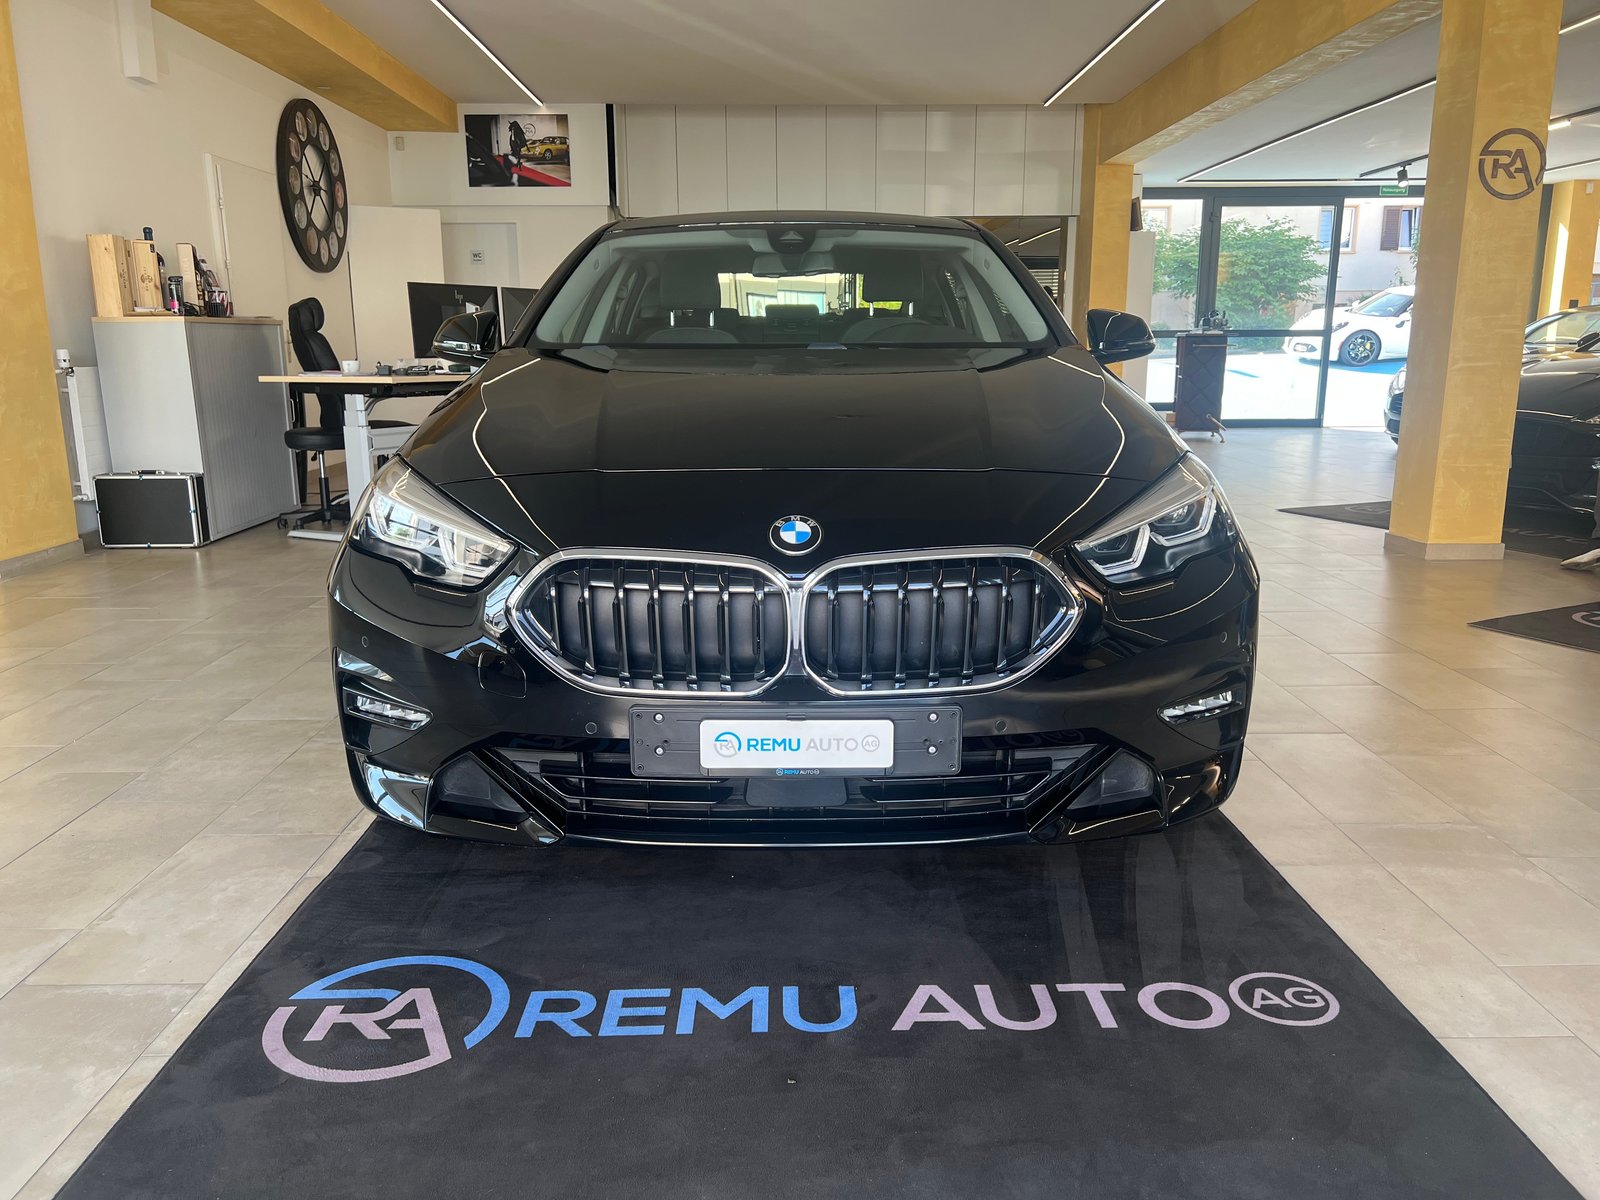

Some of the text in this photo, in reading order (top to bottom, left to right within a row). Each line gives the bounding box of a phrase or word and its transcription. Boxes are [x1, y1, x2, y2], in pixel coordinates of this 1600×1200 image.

[1479, 128, 1546, 200] RA
[454, 289, 464, 304] hp
[714, 732, 742, 758] RA
[747, 738, 801, 752] REMU
[806, 738, 858, 752] AUTO
[261, 955, 510, 1083] RA
[514, 985, 858, 1038] REMU
[891, 982, 1230, 1031] AUTO
